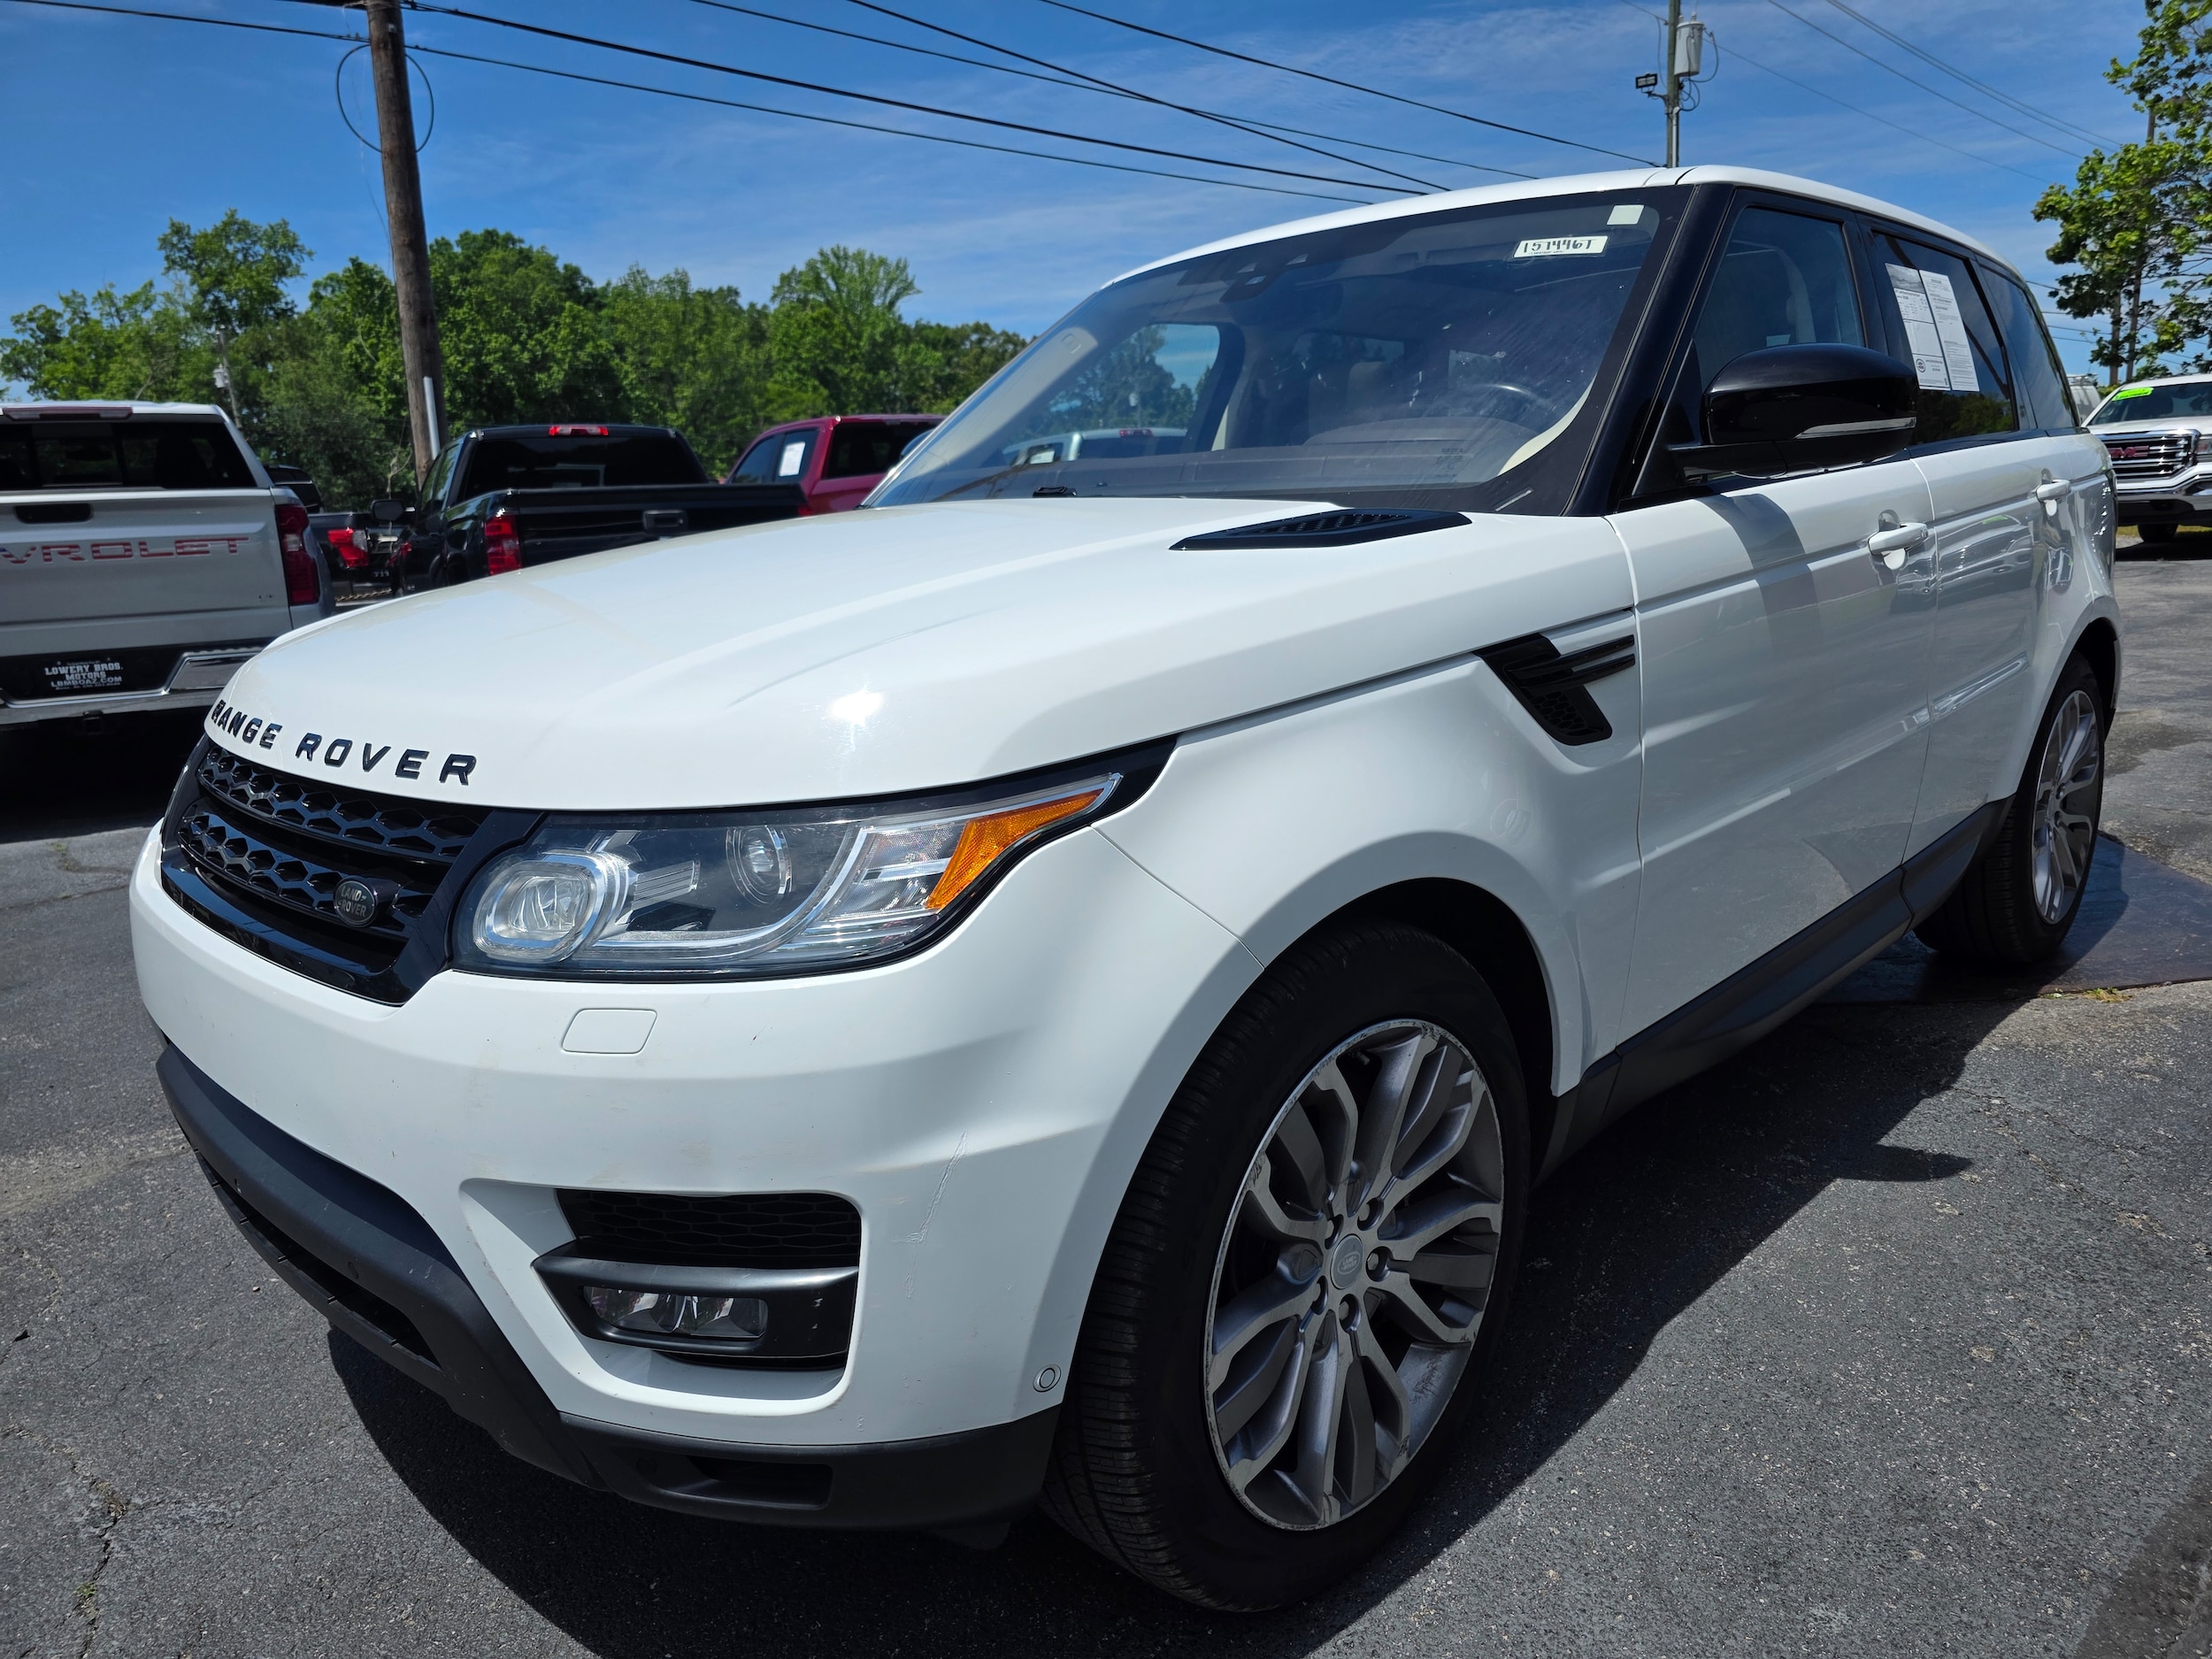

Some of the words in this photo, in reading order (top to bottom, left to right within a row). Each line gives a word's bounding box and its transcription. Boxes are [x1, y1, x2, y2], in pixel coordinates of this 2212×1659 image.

[44, 664, 90, 675] LOWERY
[94, 662, 123, 672] BROS.
[65, 672, 107, 680] MOTORS
[211, 699, 283, 749] RANGE
[295, 733, 477, 786] ROVER
[342, 886, 362, 902] LAND
[342, 899, 366, 918] ROVER
